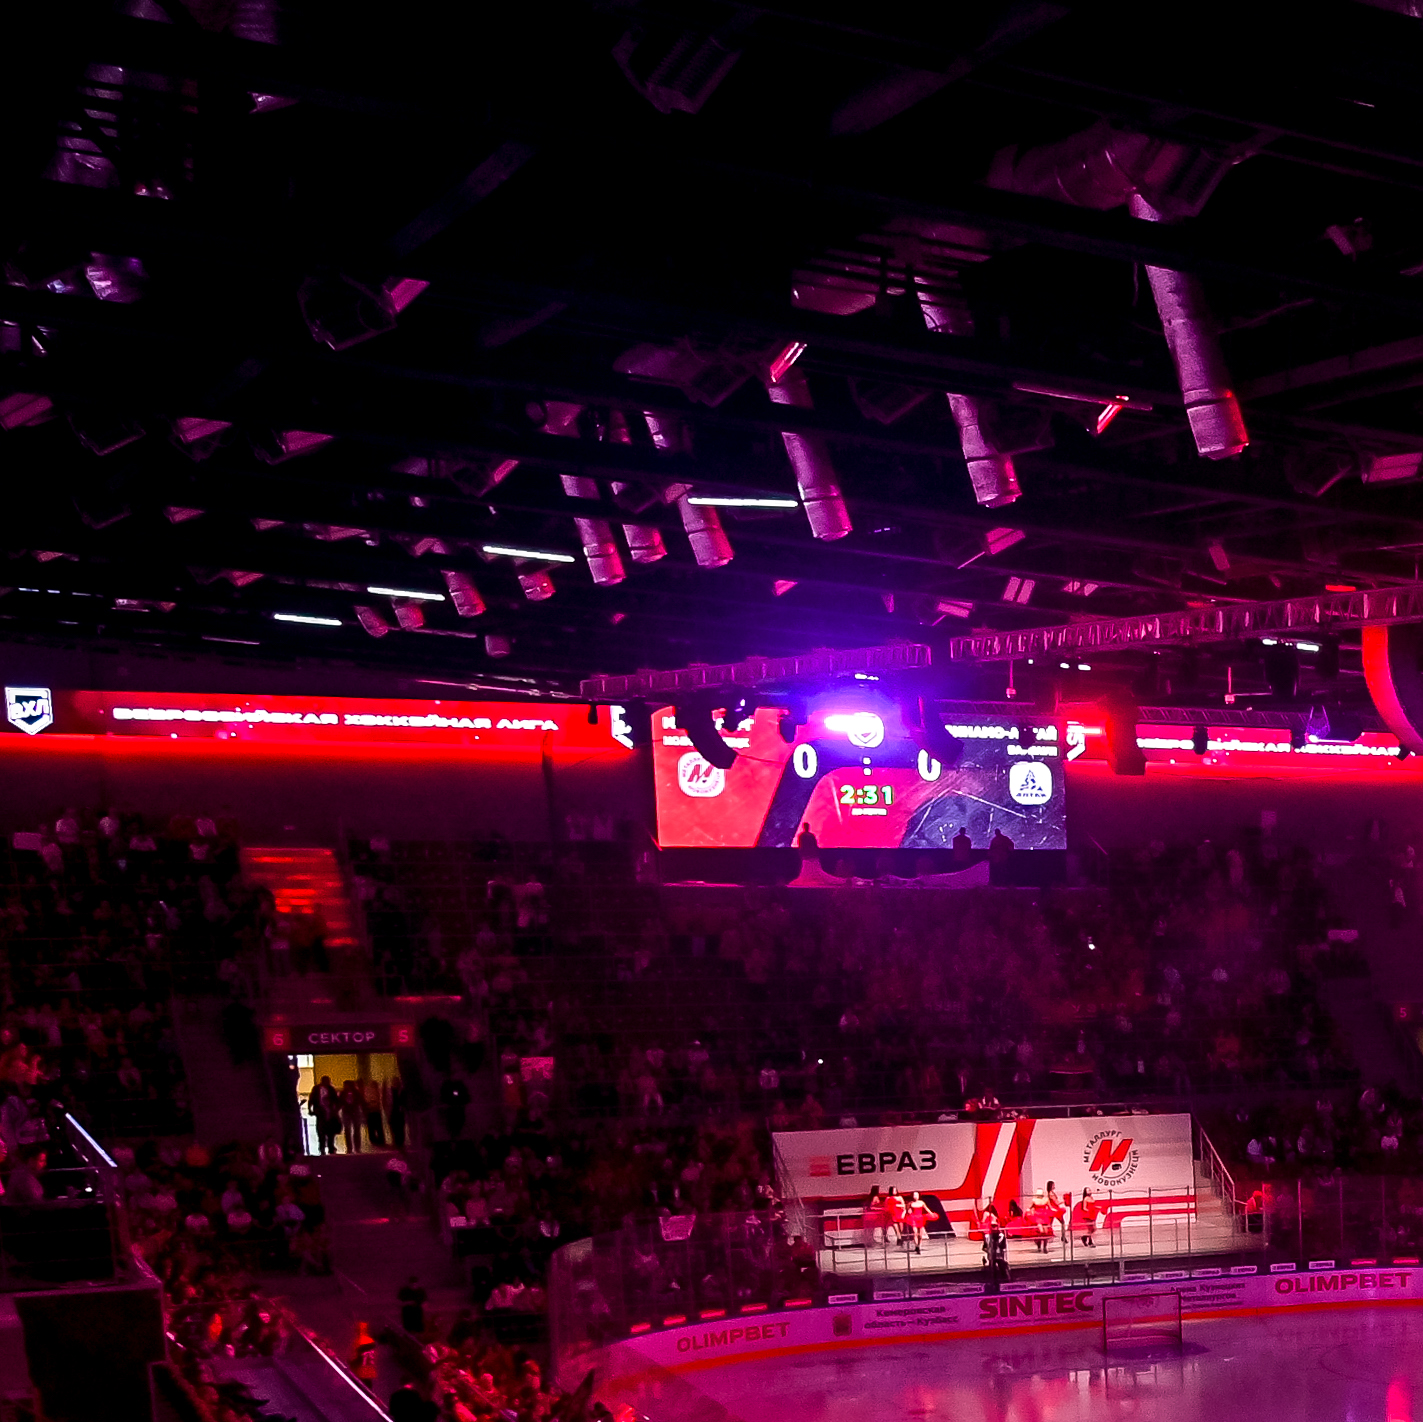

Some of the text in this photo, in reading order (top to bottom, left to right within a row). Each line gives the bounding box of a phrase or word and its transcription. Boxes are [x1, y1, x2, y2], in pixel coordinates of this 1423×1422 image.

[840, 785, 893, 805] 2:31
[308, 1031, 376, 1045] СЕКТОР
[836, 1149, 938, 1177] ЕВРАЗ
[1273, 1271, 1413, 1295] OLIMPBET
[978, 1290, 1095, 1321] SINTEC
[676, 1321, 791, 1353] OLIMPBET
